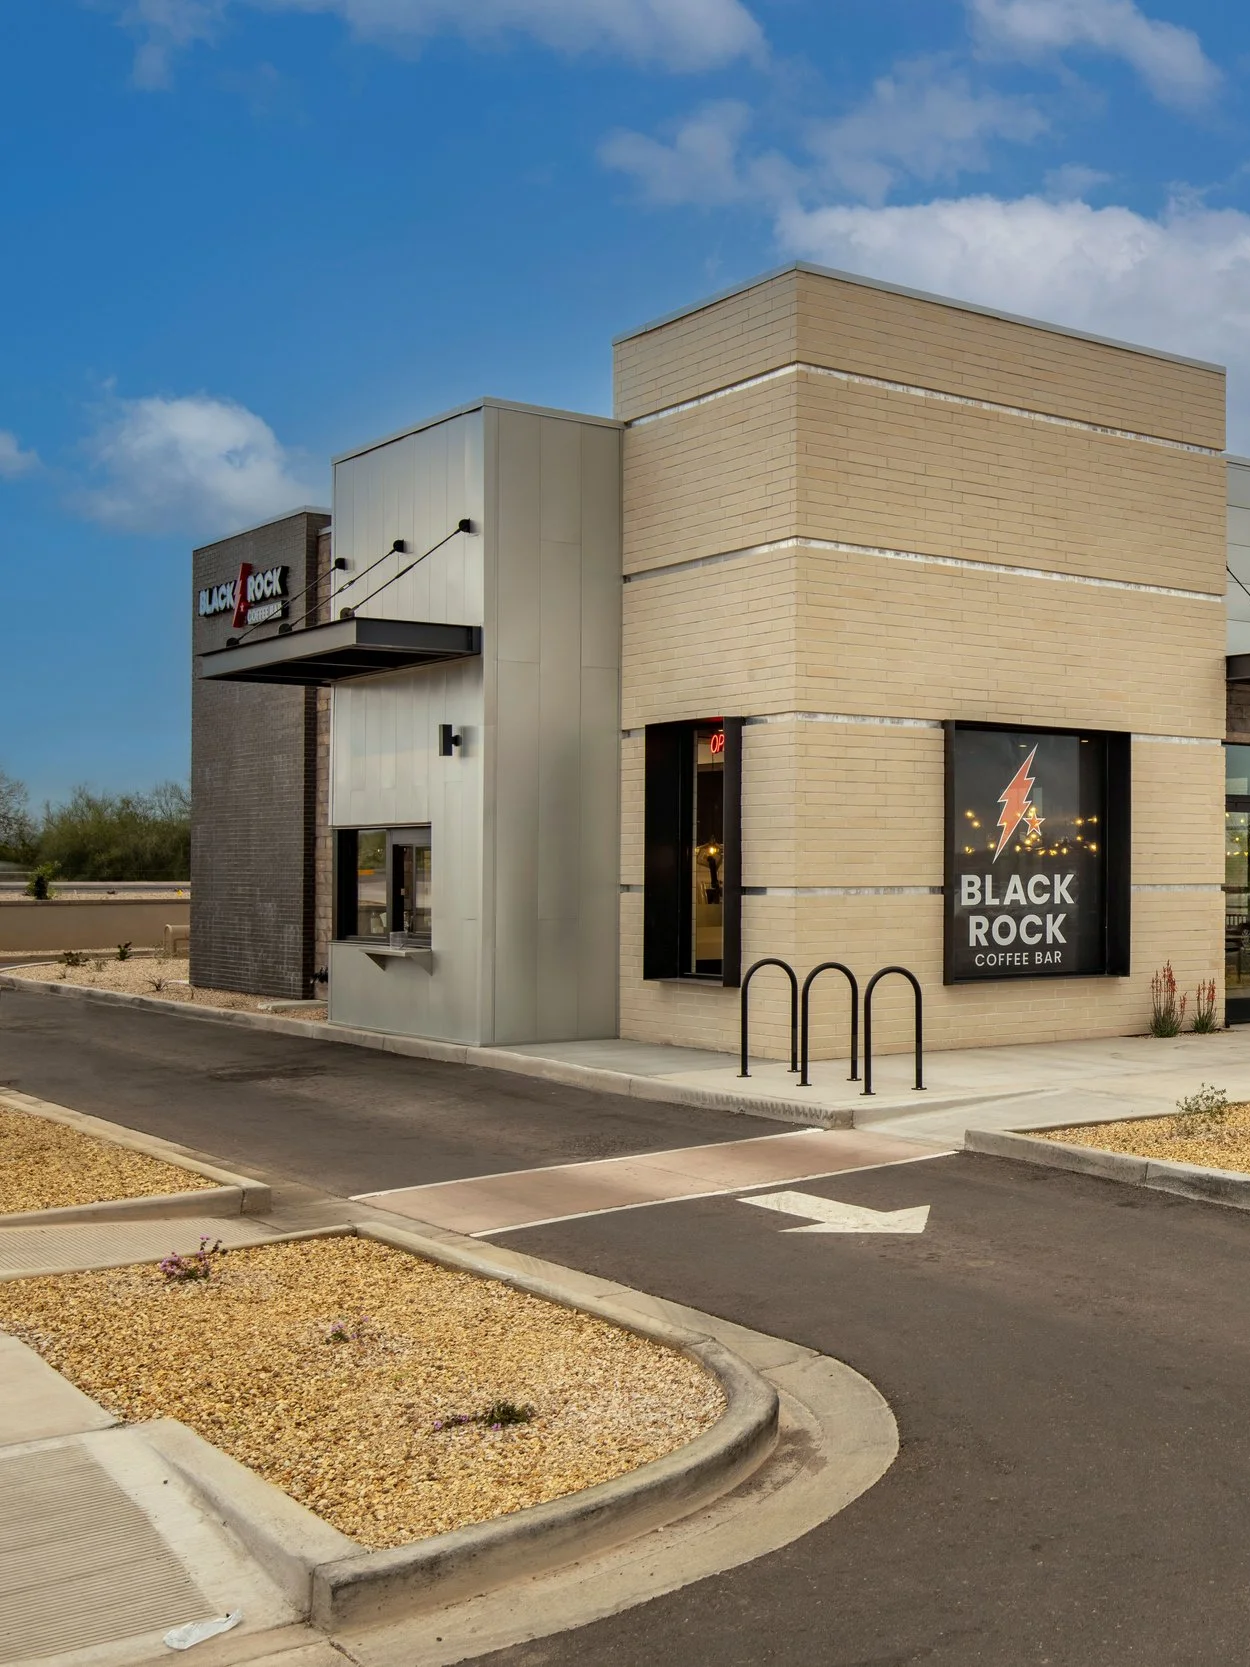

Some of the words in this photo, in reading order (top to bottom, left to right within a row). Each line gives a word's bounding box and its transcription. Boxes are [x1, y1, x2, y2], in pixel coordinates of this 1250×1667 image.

[199, 580, 235, 616] BLACK
[247, 567, 283, 602] ROCK
[711, 734, 724, 753] OP
[960, 874, 1075, 906] BLACK
[969, 913, 1067, 947] ROCK
[975, 952, 1029, 967] COFFEE
[1035, 951, 1062, 964] BAR
